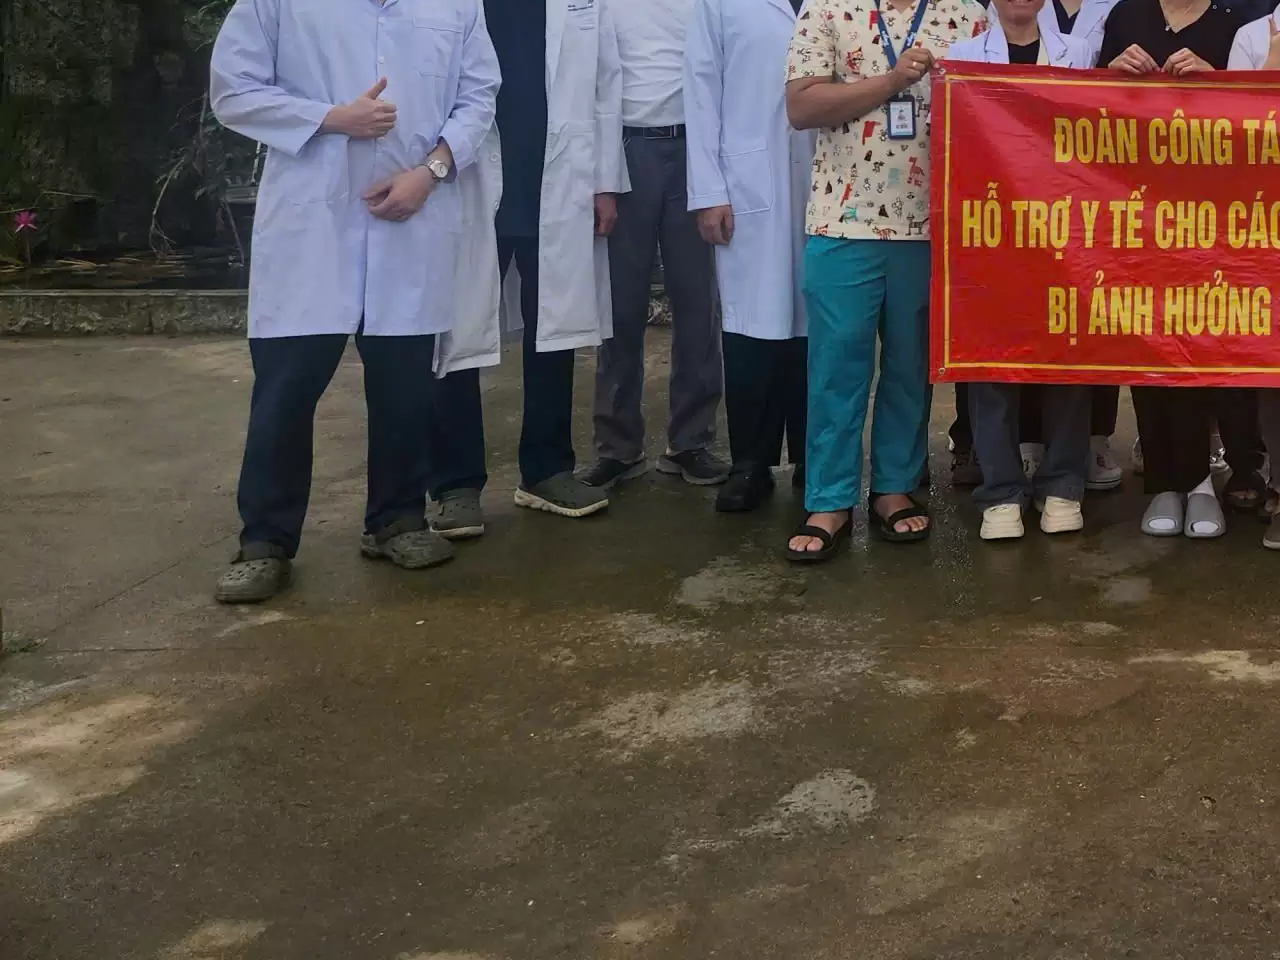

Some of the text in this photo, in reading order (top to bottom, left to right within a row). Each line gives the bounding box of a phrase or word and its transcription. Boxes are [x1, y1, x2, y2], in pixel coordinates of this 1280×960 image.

[1054, 107, 1138, 164] ĐOÀN
[1148, 108, 1233, 165] CÔNG
[962, 182, 1002, 248] HỖ
[1012, 195, 1072, 259] TRỢ
[1081, 201, 1099, 248] Y
[1109, 185, 1147, 249] TẾ
[1155, 201, 1216, 248] CHO
[1049, 286, 1077, 345] BỊ
[1088, 270, 1154, 336] ẢNH
[1164, 272, 1270, 335] HƯỞNG
